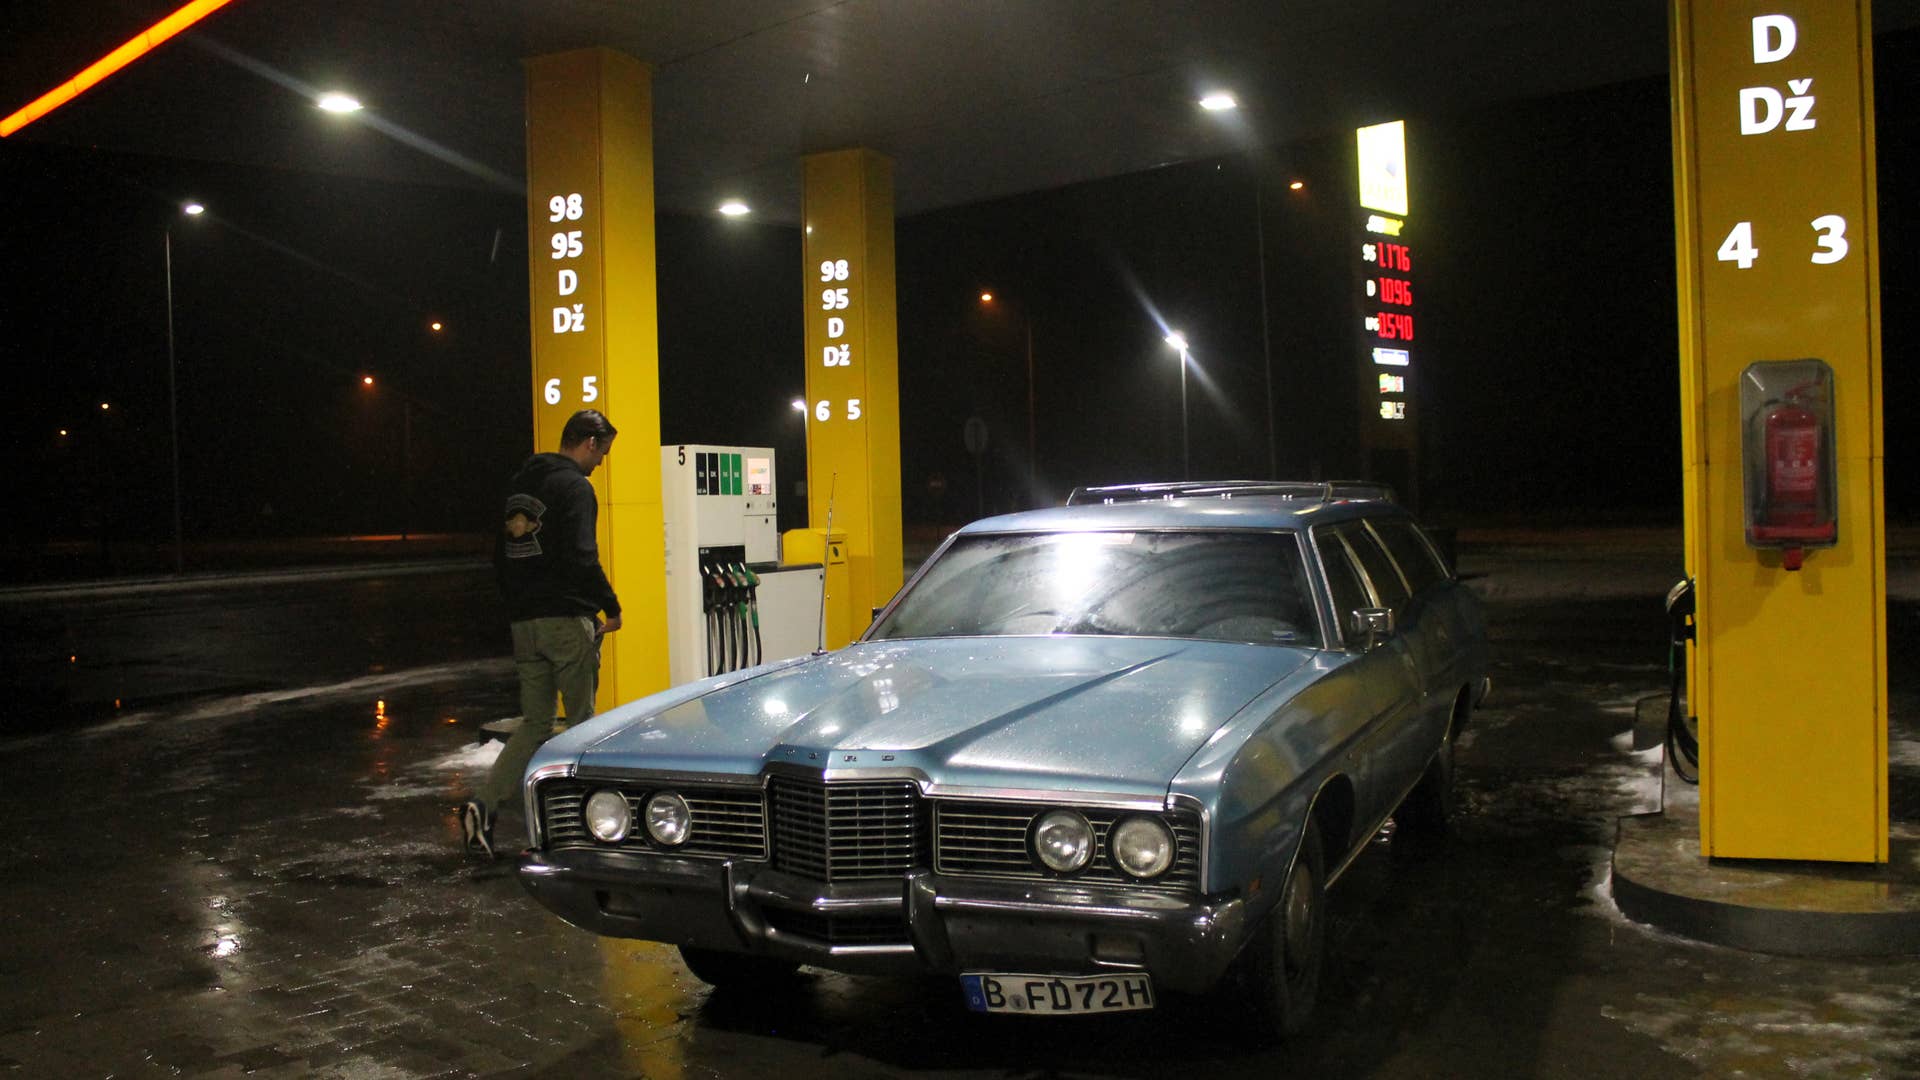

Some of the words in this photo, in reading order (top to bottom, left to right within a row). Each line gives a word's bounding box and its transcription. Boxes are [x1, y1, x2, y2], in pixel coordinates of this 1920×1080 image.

[1751, 13, 1798, 64] D
[1739, 77, 1817, 136] Dž
[549, 192, 584, 223] 98
[550, 230, 584, 260] 95
[1362, 243, 1377, 262] 95
[1716, 221, 1759, 269] 4
[1810, 214, 1849, 265] 3
[558, 269, 578, 296] D
[819, 259, 850, 283] 98
[821, 287, 850, 311] 95
[552, 303, 586, 334] Dž
[827, 317, 845, 339] D
[823, 343, 851, 367] Dž
[544, 378, 561, 405] 6
[582, 375, 599, 403] 5
[815, 399, 831, 422] 6
[846, 398, 862, 421] 5
[678, 446, 685, 465] 5
[984, 977, 1006, 1008] B
